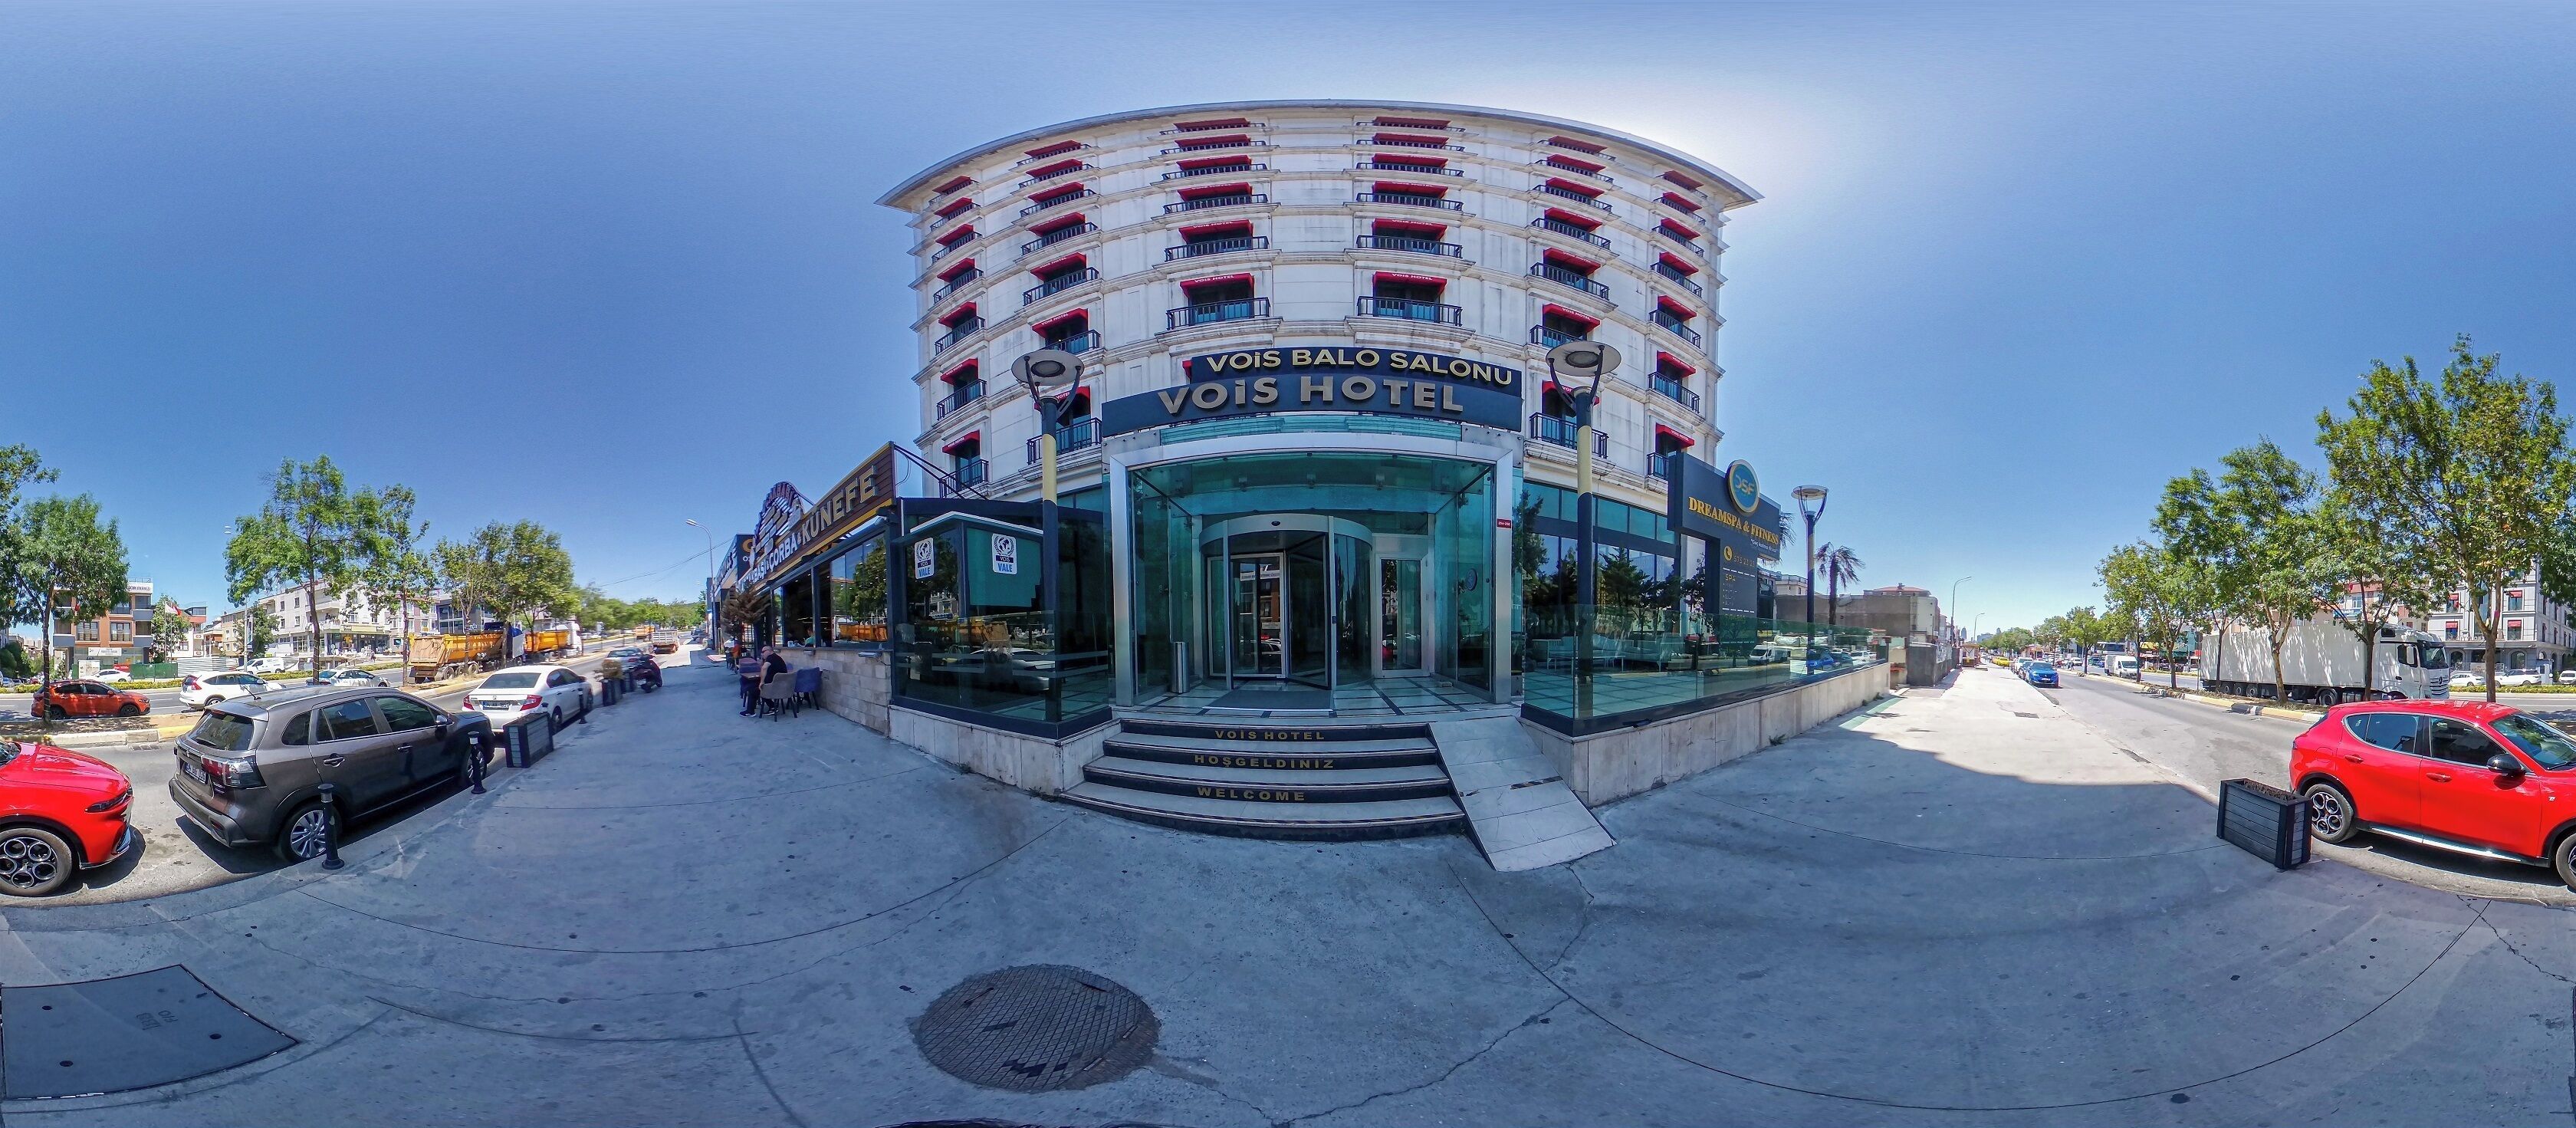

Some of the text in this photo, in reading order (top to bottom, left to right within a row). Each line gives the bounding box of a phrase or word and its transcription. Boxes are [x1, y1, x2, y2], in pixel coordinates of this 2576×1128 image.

[1292, 349, 1380, 367] BALO
[1389, 352, 1513, 385] SALONU
[1300, 375, 1464, 412] HOTEL
[1688, 496, 1779, 545] DREAMSPA & FITNESS
[769, 532, 798, 573] ÇORBA
[918, 567, 931, 577] VALE
[997, 563, 1013, 573] VALE
[1264, 732, 1325, 740] HOTEL
[1197, 787, 1305, 801] WELCOME
